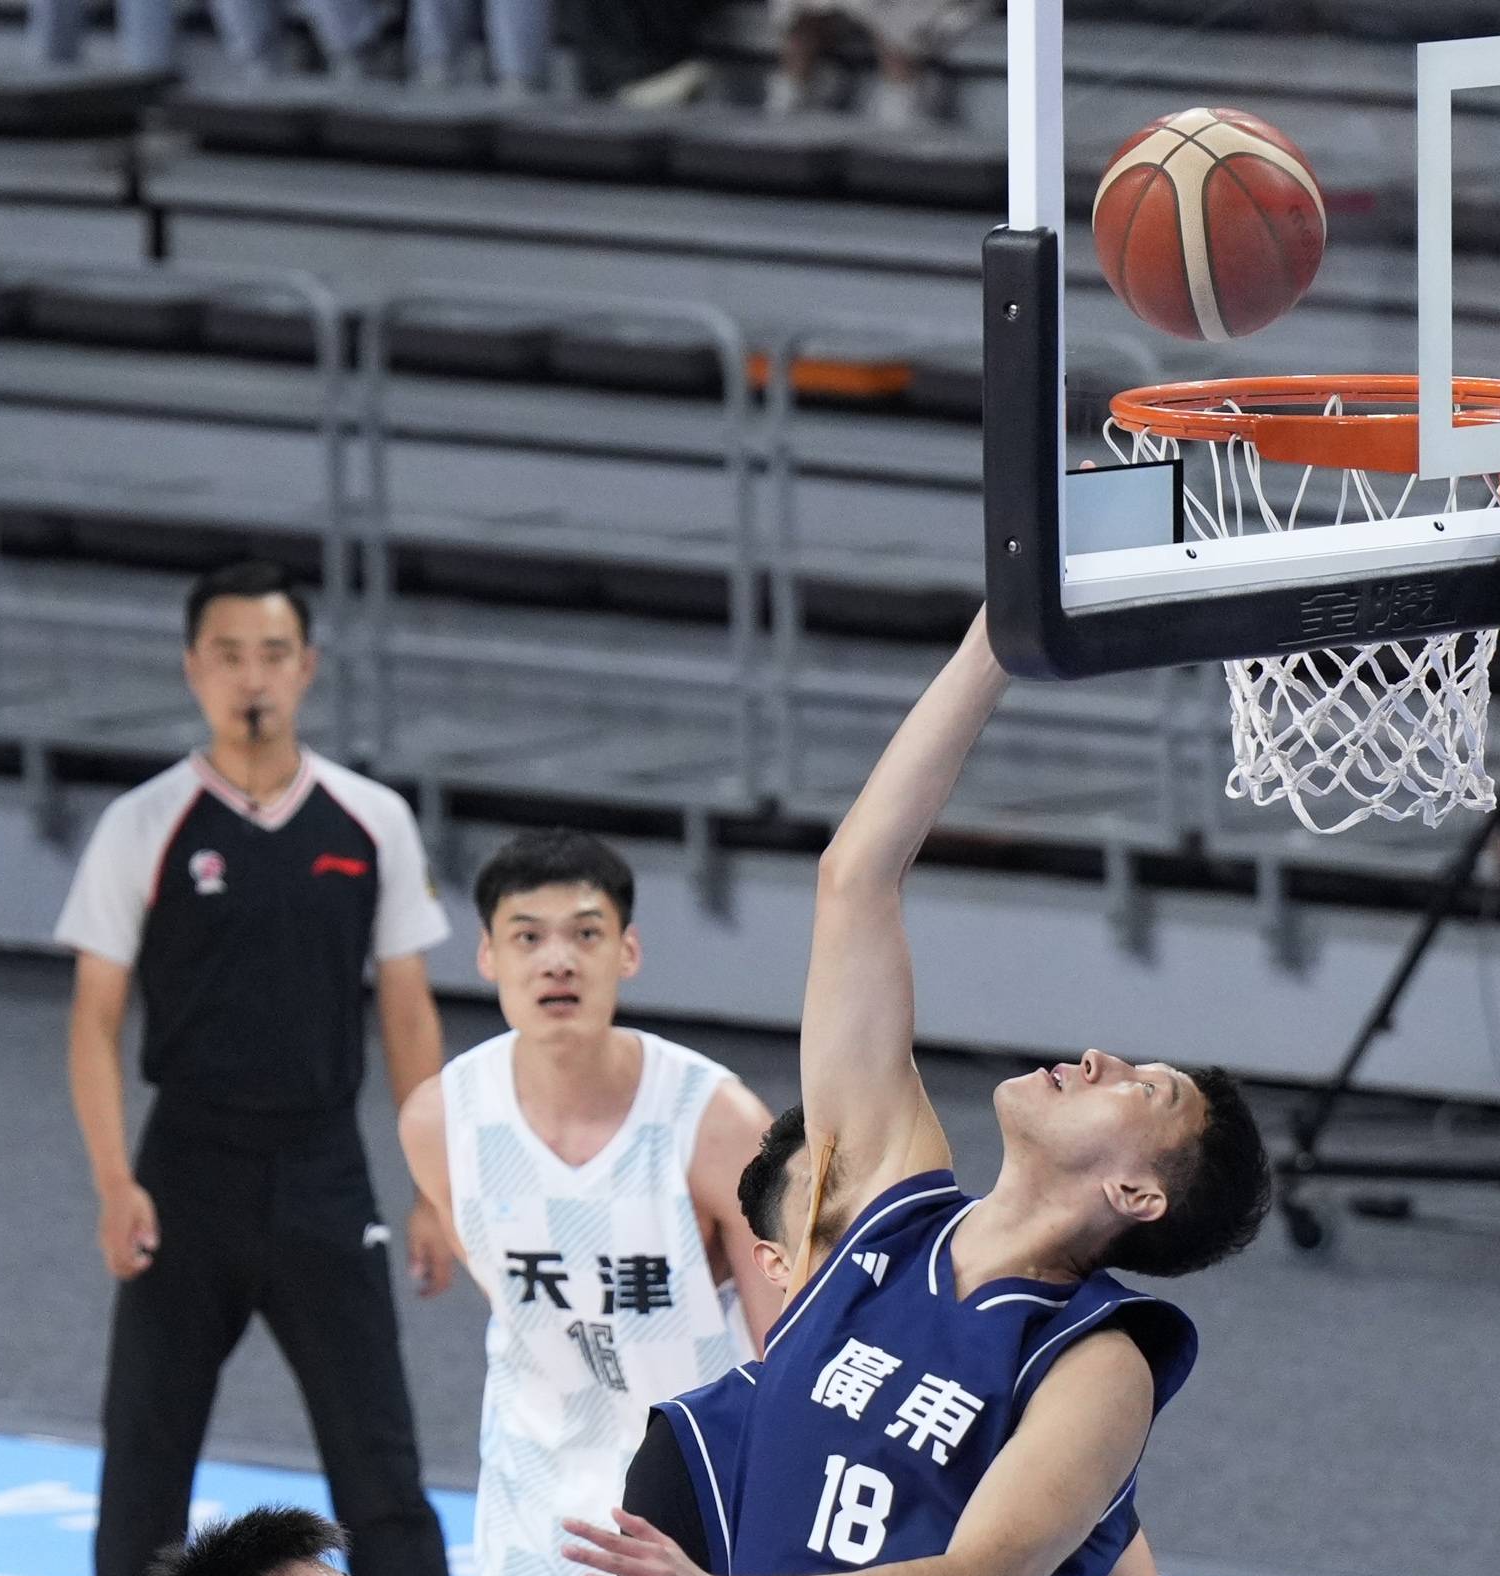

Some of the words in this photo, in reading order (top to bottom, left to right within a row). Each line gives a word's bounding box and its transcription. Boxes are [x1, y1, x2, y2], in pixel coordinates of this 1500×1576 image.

[506, 1251, 673, 1315] 天津
[810, 1336, 986, 1467] 廣東
[806, 1454, 896, 1566] 18
